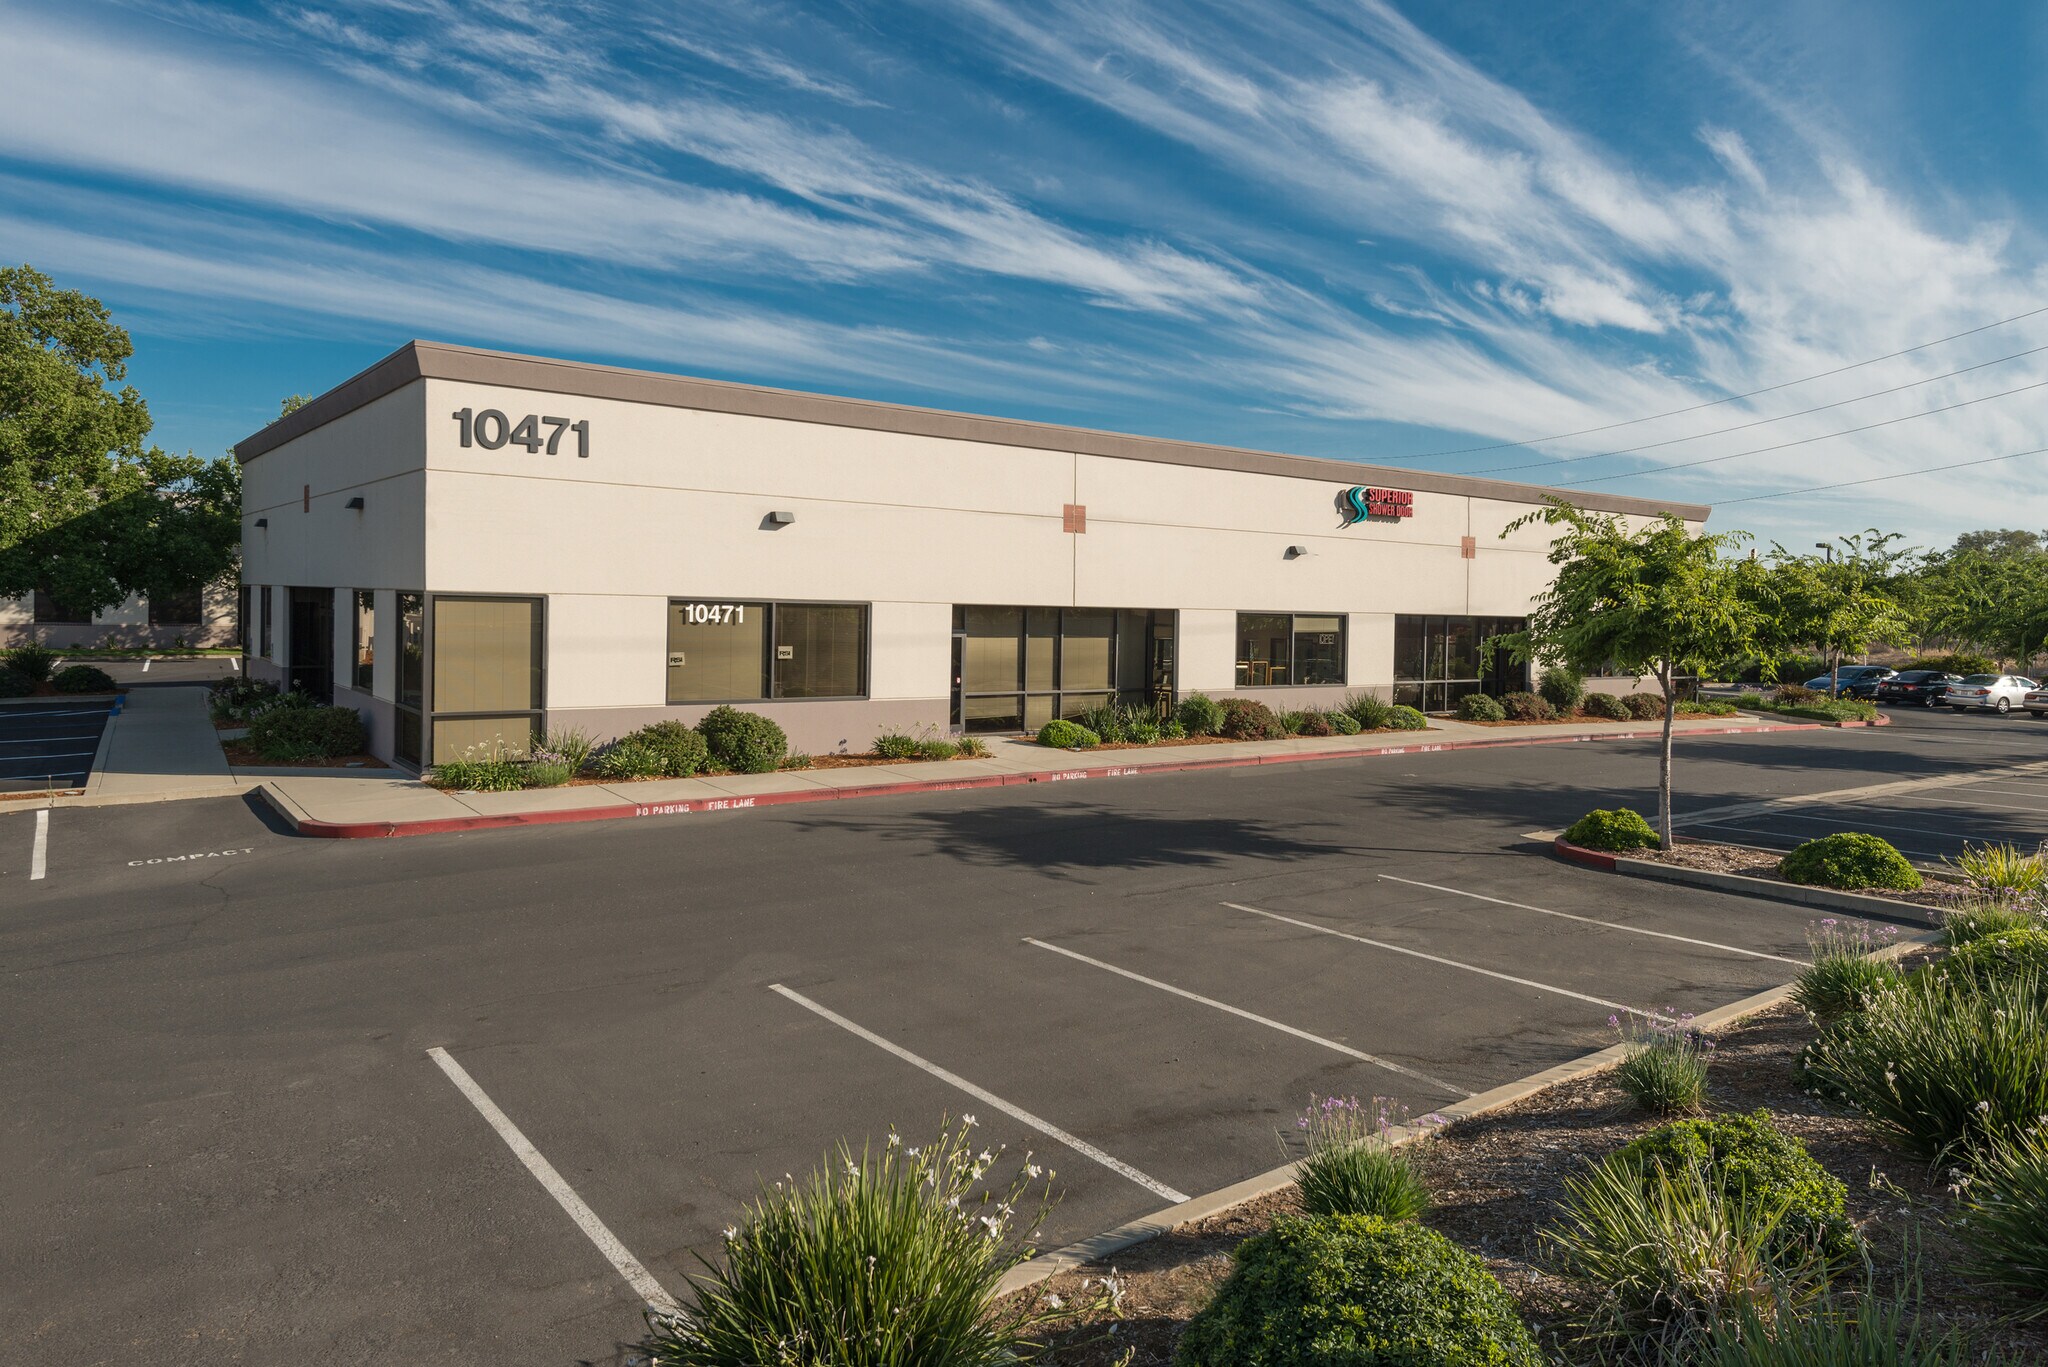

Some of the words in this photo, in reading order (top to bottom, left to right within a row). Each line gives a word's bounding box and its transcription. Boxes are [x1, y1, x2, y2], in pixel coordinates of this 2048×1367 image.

[452, 408, 589, 458] 10471
[1369, 488, 1413, 505] SUPERIOR
[1369, 503, 1395, 516] SHOWER
[1396, 506, 1413, 517] DOOR
[685, 604, 744, 624] 10471
[1051, 773, 1060, 781] NO
[1063, 771, 1087, 780] PARKING
[1107, 769, 1121, 777] FIRE
[1123, 767, 1139, 775] LANE
[636, 807, 648, 816] NO
[653, 804, 690, 815] PARKING
[707, 800, 728, 811] FIRE
[733, 798, 756, 809] LANE
[128, 847, 254, 866] COMPACT
